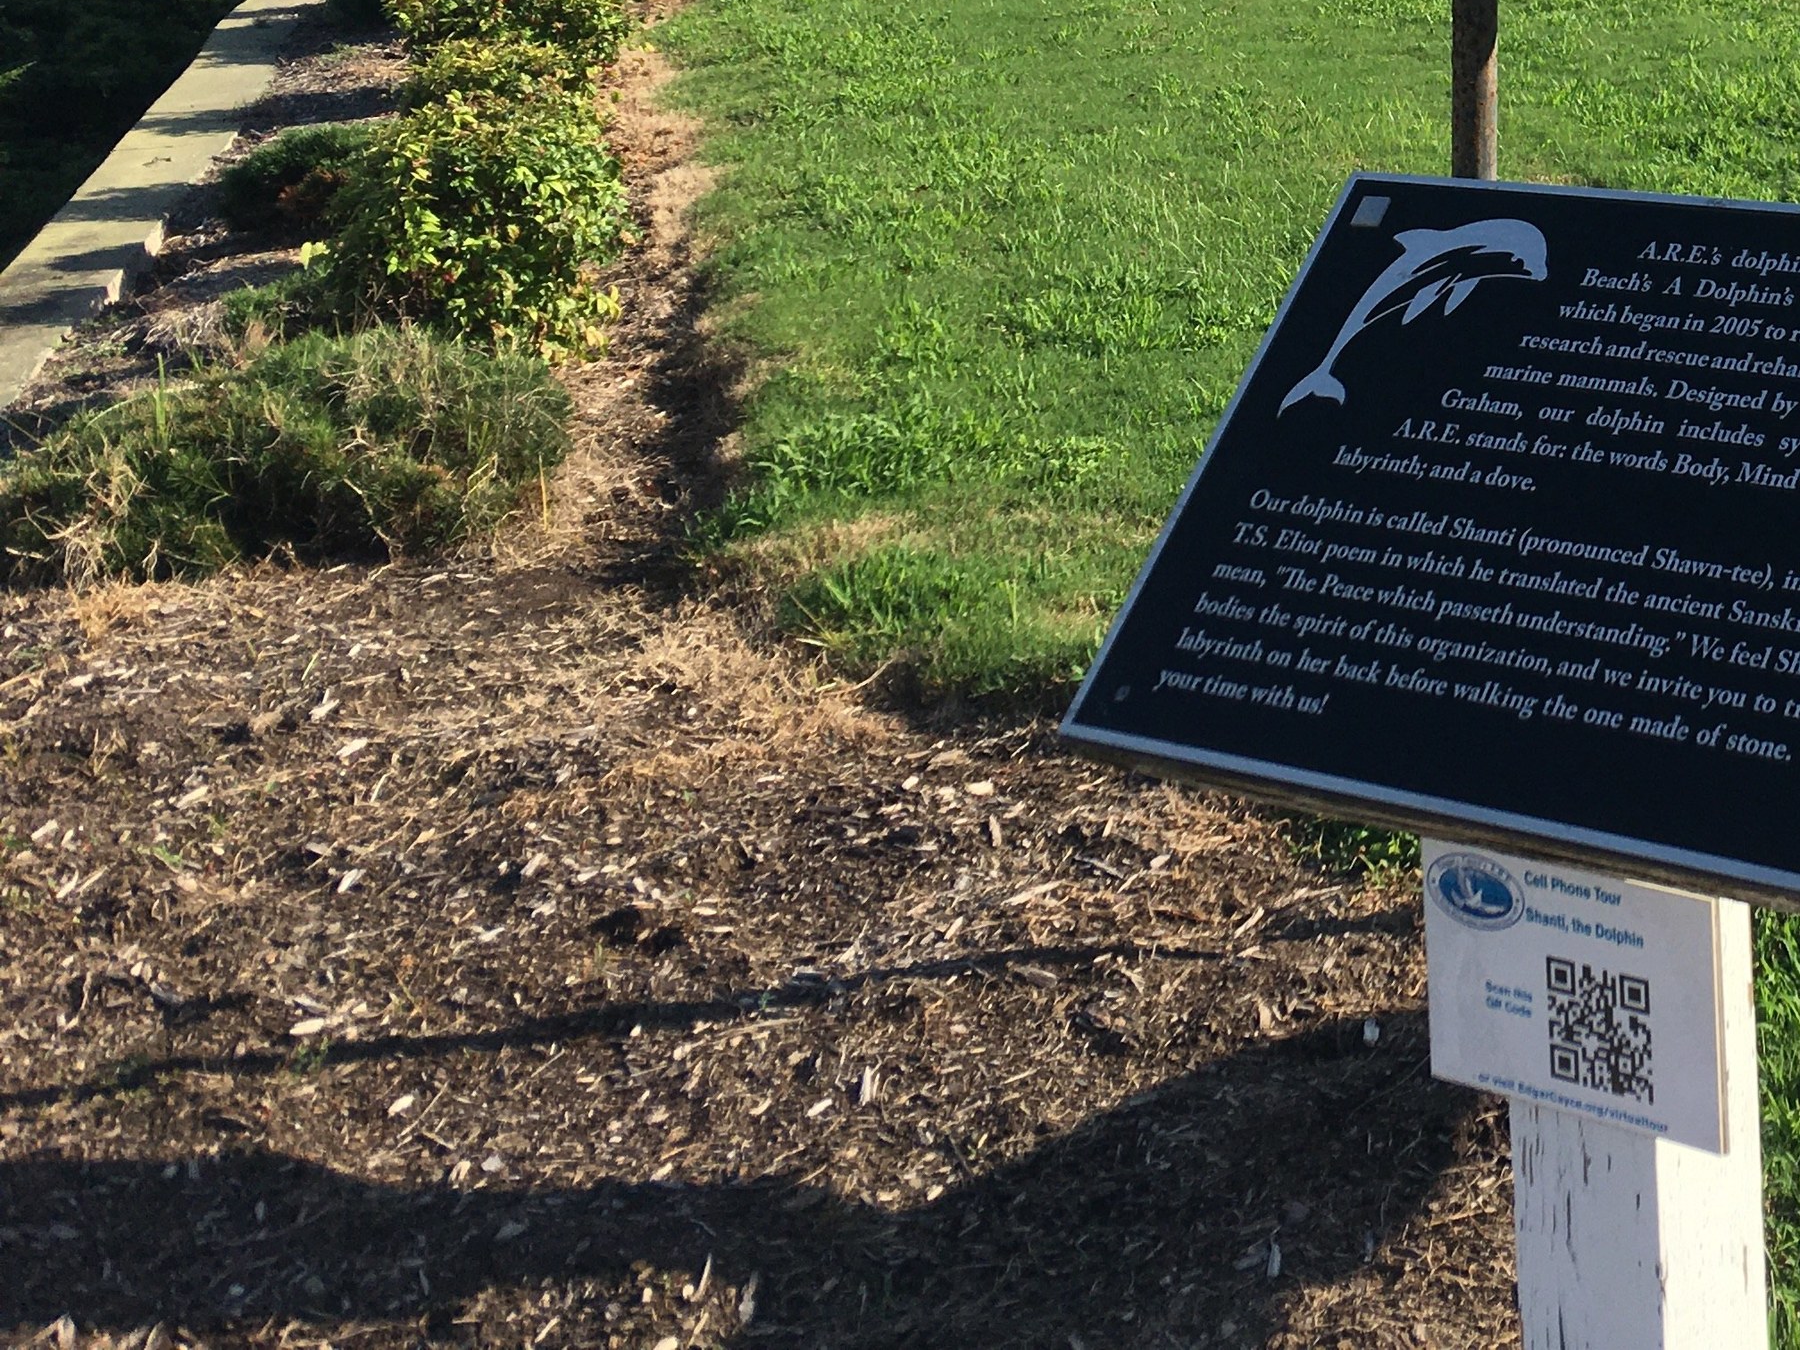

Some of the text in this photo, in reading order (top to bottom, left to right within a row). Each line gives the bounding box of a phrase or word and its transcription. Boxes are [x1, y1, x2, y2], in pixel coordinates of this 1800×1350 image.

[1661, 275, 1681, 296] A
[1559, 299, 1617, 323] which
[1618, 304, 1680, 333] began
[1681, 312, 1705, 332] in
[1708, 315, 1764, 338] 2005
[1763, 324, 1786, 341] to
[1518, 335, 1603, 356] research
[1604, 340, 1648, 360] and
[1643, 348, 1710, 368] rescue
[1709, 351, 1754, 372] and
[1440, 387, 1523, 421] Graham,
[1537, 406, 1576, 422] our
[1585, 405, 1665, 436] dolphin
[1676, 418, 1765, 447] includes
[1482, 364, 1553, 384] marine
[1555, 373, 1658, 398] mammals.
[1664, 378, 1769, 412] Designed
[1770, 391, 1799, 420] by
[1332, 444, 1536, 492] labyrinth; and a dove.
[1392, 417, 1461, 445] A.R.E.
[1464, 431, 1529, 453] stands
[1529, 434, 1567, 458] for:
[1570, 440, 1605, 463] the
[1609, 449, 1669, 472] words
[1670, 452, 1730, 486] Body,
[1249, 488, 1291, 513] Our
[1290, 494, 1364, 525] dolphin
[1364, 506, 1385, 526] is
[1385, 510, 1449, 536] called
[1447, 517, 1517, 547] Shanti
[1517, 526, 1650, 567] (pronounced
[1650, 547, 1774, 591] Shawn-tee),
[1232, 521, 1269, 547] T.S.
[1272, 528, 1323, 555] Eliot
[1319, 543, 1377, 563] poem
[1379, 546, 1403, 568] in
[1406, 550, 1465, 577] which
[1467, 558, 1494, 582] he
[1497, 567, 1604, 599] translated
[1604, 580, 1640, 606] the
[1643, 593, 1725, 620] ancient
[1211, 563, 1266, 588] mean,
[1318, 573, 1375, 602] Peace
[1376, 584, 1436, 612] which
[1434, 600, 1514, 625] passeth
[1690, 633, 1725, 661] We
[1728, 641, 1773, 669] feel
[1193, 591, 1256, 620] bodies
[1258, 602, 1291, 627] the
[1292, 612, 1348, 637] spirit
[1348, 619, 1378, 641] of
[1373, 622, 1414, 648] this
[1416, 636, 1552, 676] organization,
[1555, 657, 1601, 681] and
[1603, 668, 1633, 687] we
[1635, 669, 1703, 700] invite
[1700, 687, 1747, 709] you
[1753, 693, 1777, 713] to
[1152, 669, 1330, 715] your time with us!
[1176, 626, 1263, 662] labyrinth
[1266, 649, 1292, 667] on
[1296, 647, 1332, 674] her
[1333, 654, 1381, 684] back
[1384, 663, 1448, 696] before
[1453, 680, 1539, 719] walking
[1541, 693, 1578, 720] the
[1583, 707, 1623, 728] one
[1628, 714, 1690, 741] made
[1695, 723, 1728, 747] of
[1725, 733, 1792, 761] stone.
[1524, 870, 1621, 906] Cell Phone Tour
[1525, 907, 1568, 933] Shanti,
[1572, 917, 1591, 936] the
[1595, 923, 1644, 949] Dolphin
